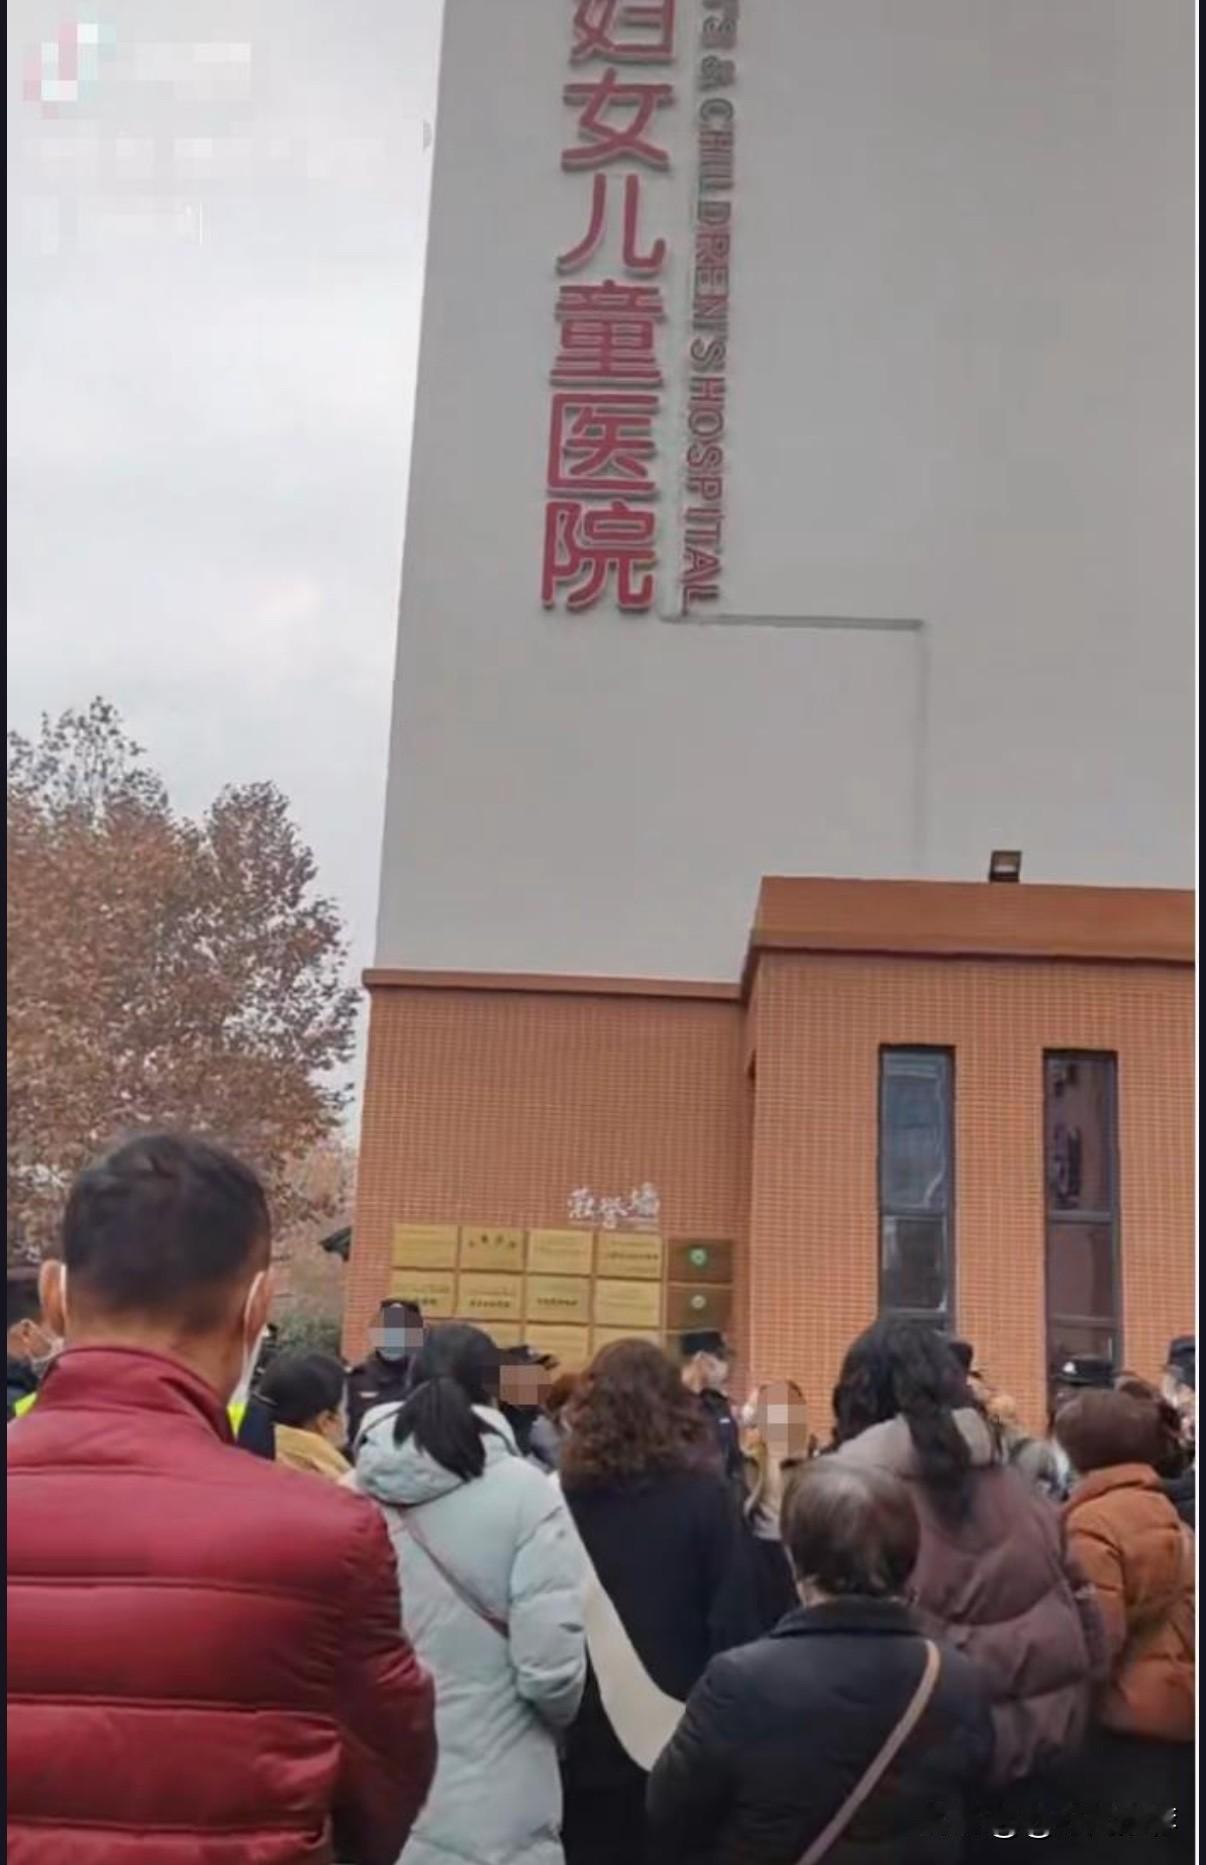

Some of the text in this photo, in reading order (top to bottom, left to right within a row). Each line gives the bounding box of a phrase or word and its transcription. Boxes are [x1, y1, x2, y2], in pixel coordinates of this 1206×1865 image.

[541, 0, 675, 612] 妇女儿童医院
[681, 376, 726, 615] HOSPITAL
